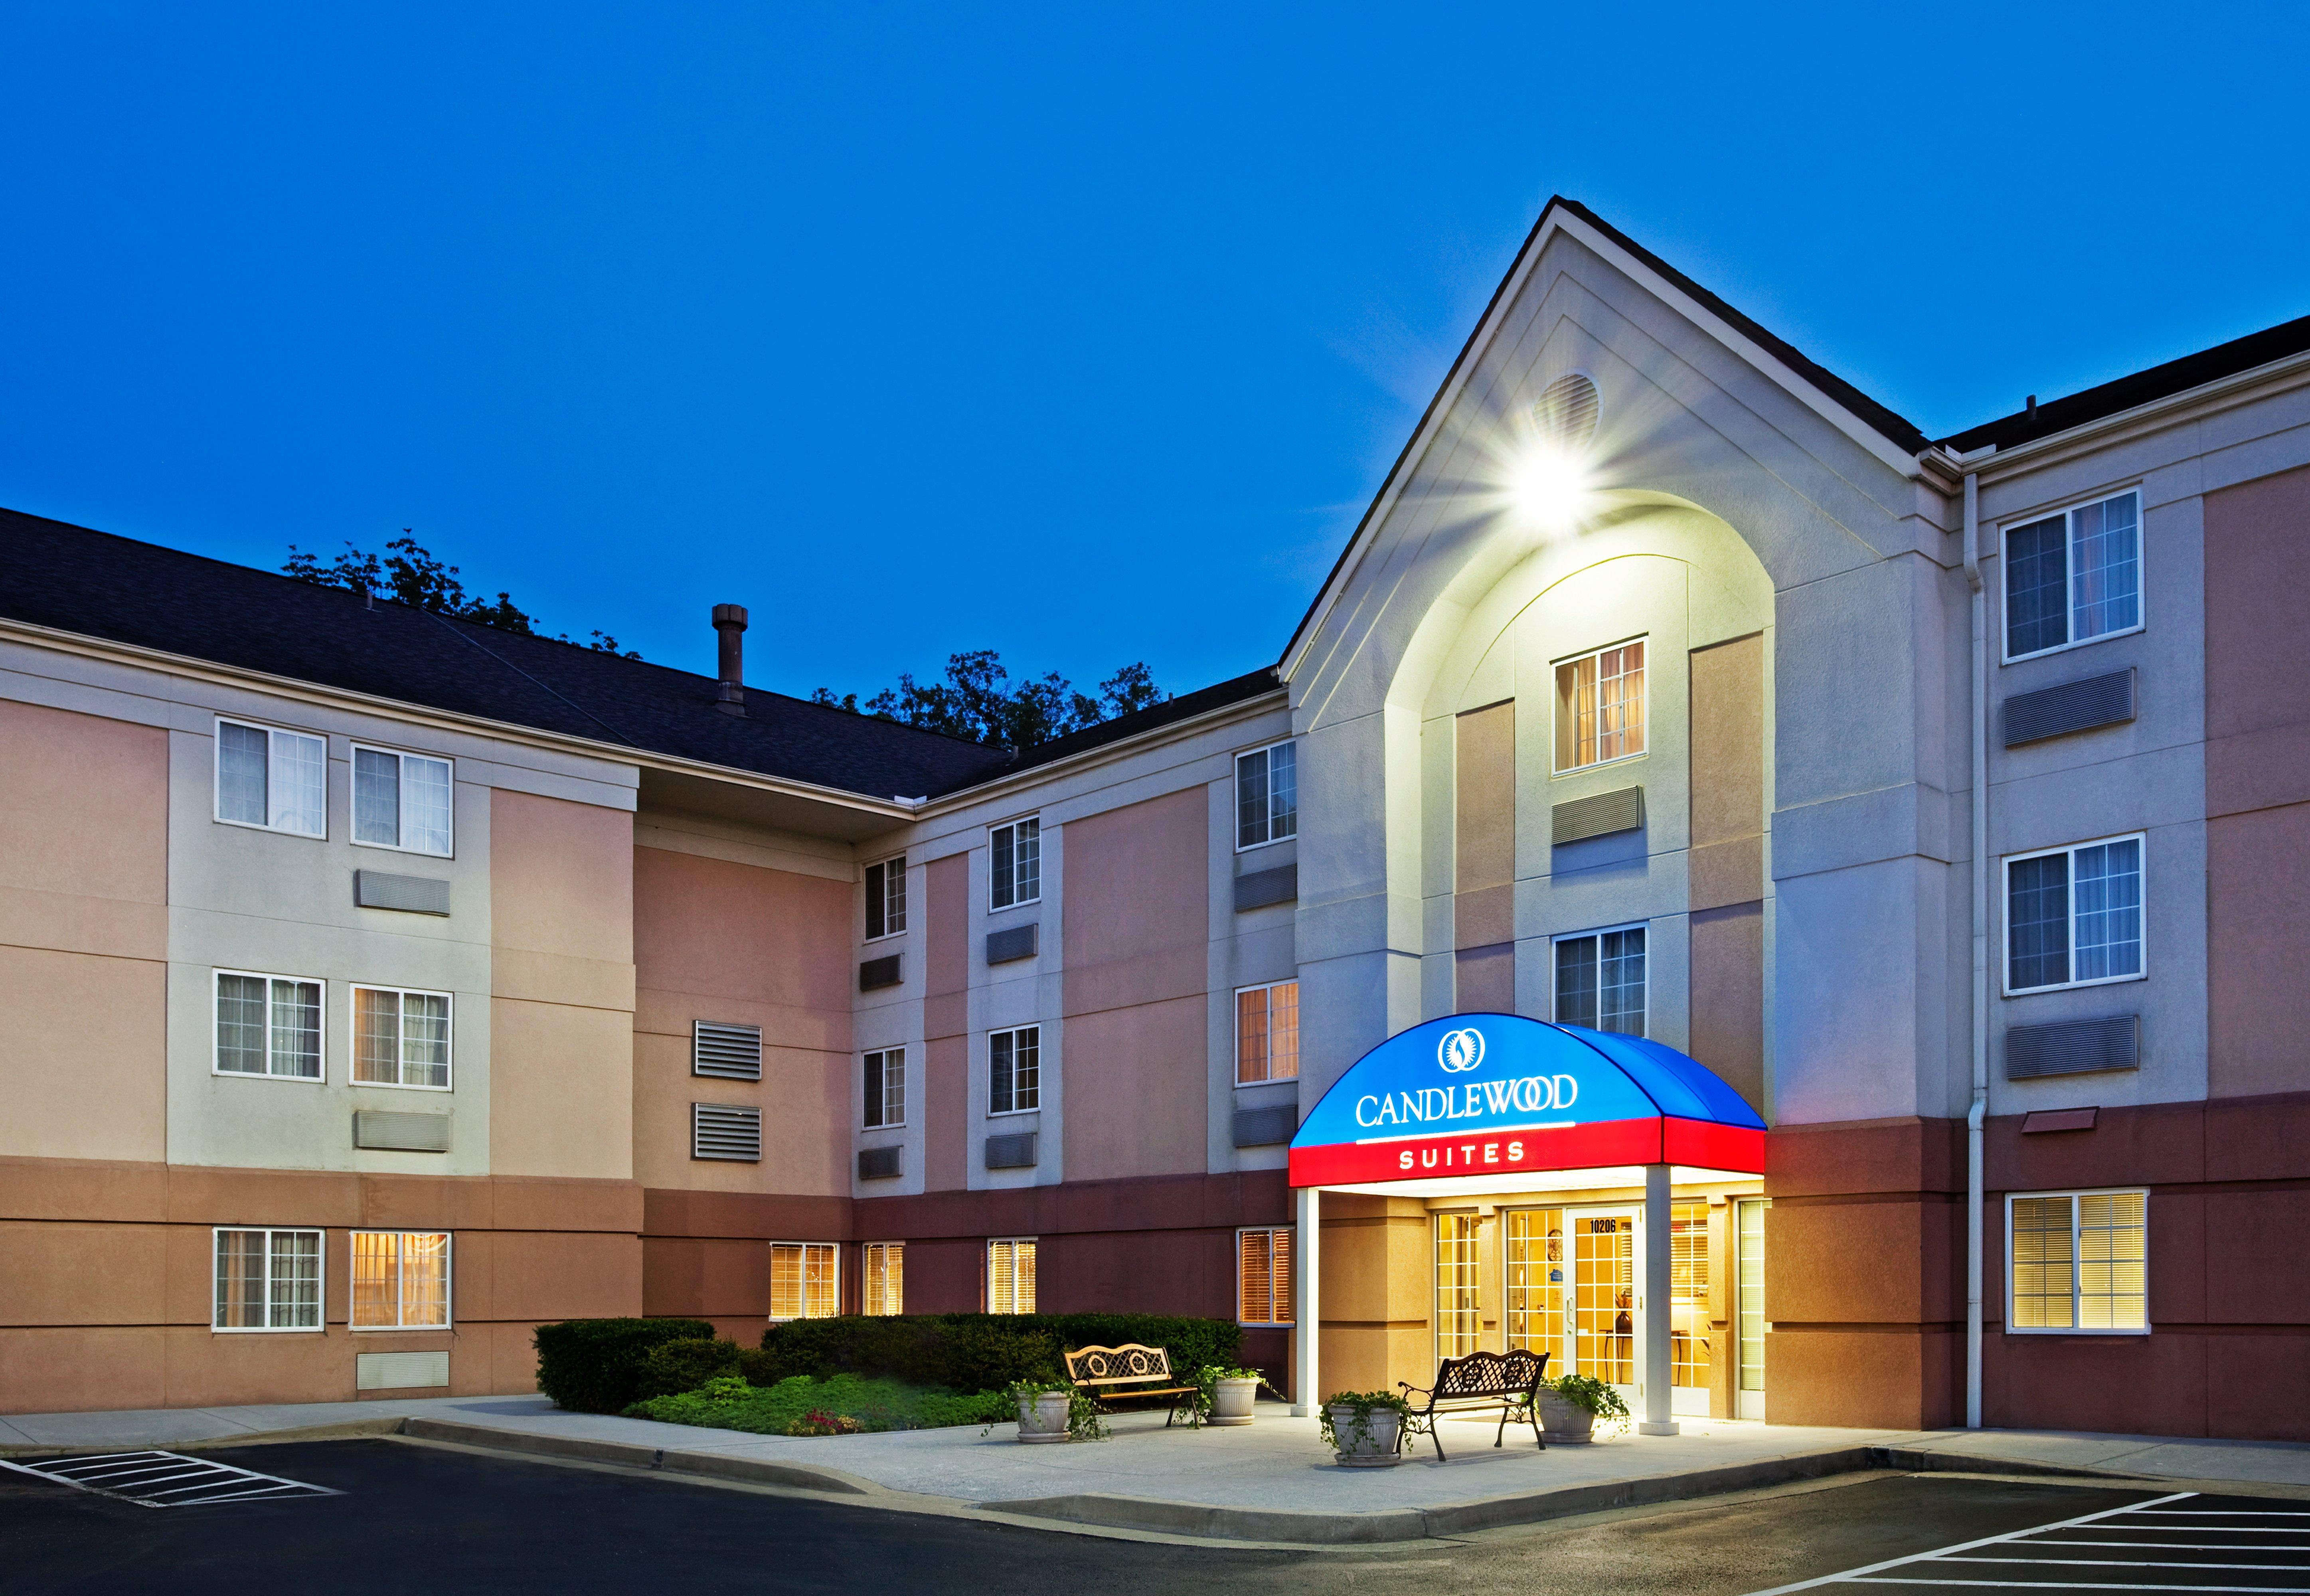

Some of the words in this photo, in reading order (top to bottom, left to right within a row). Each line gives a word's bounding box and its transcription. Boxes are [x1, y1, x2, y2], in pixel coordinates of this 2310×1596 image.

[1356, 1074, 1578, 1127] CANDLEWOOD
[1399, 1142, 1524, 1169] SUITES
[1590, 1219, 1616, 1233] 10206
